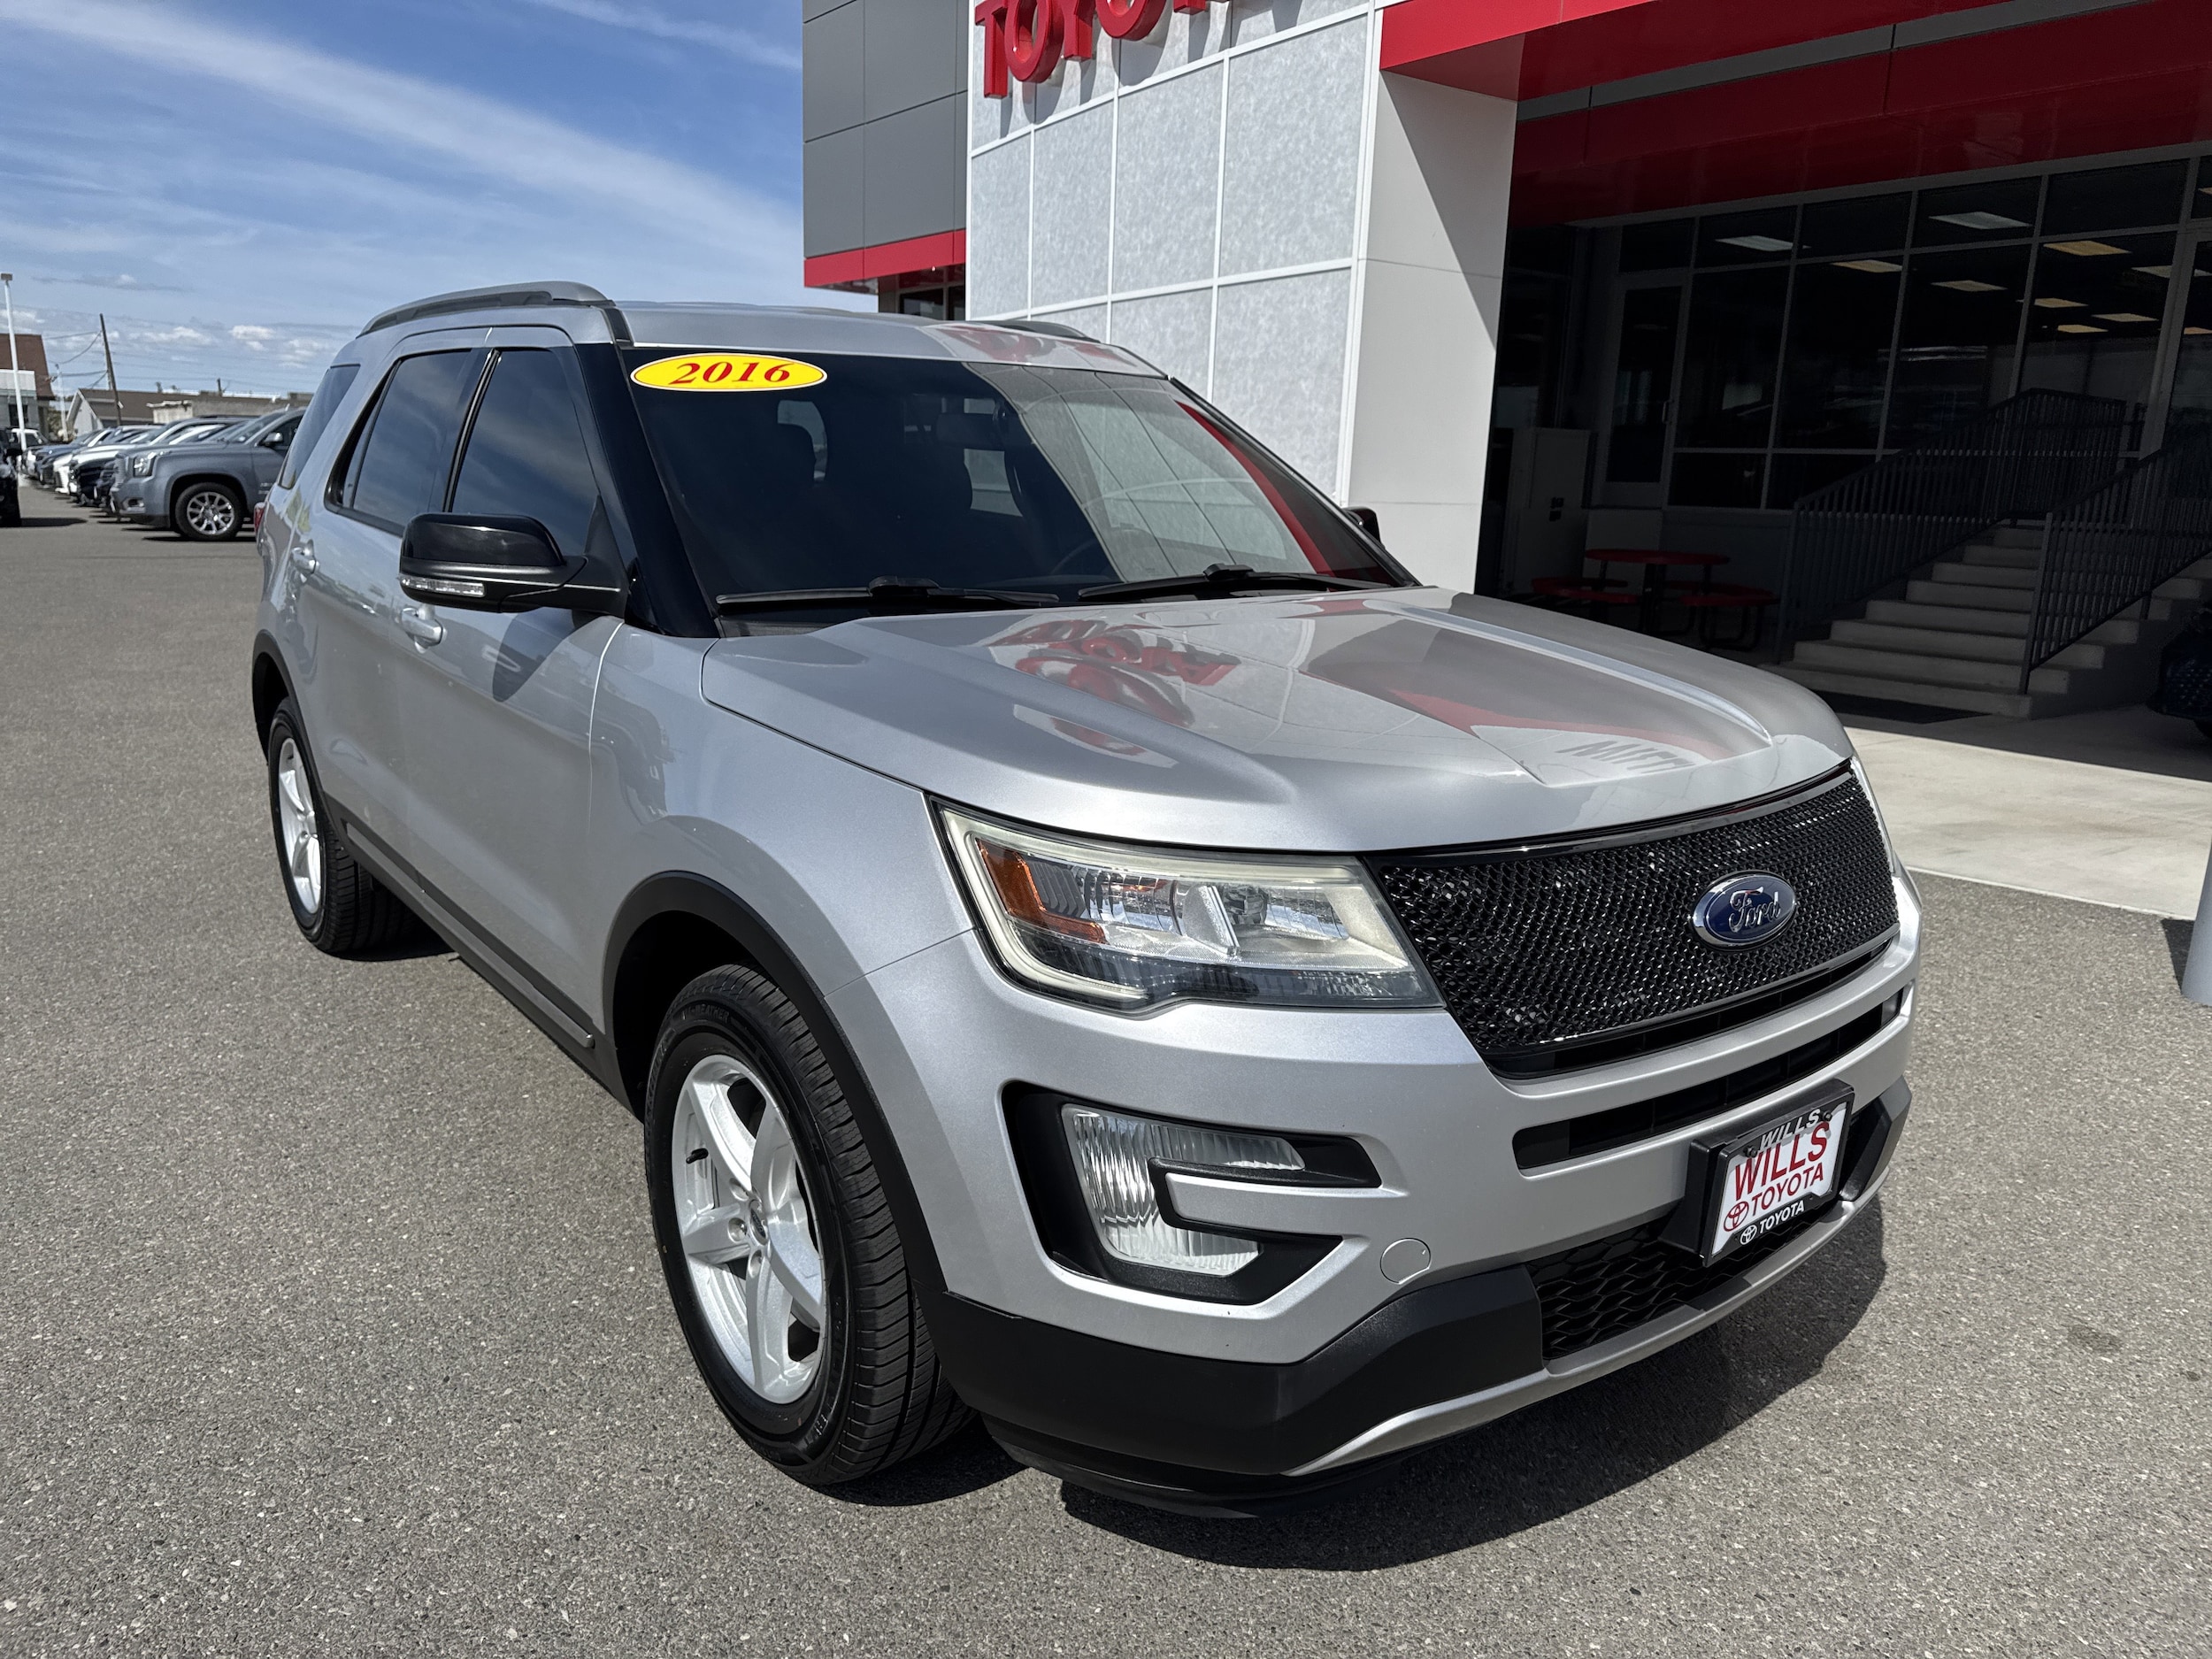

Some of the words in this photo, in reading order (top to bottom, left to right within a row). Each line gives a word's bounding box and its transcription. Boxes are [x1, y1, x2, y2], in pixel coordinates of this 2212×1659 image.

[975, 0, 1206, 99] TOY
[669, 361, 795, 385] 2016
[1728, 886, 1781, 933] Ford
[1760, 1108, 1821, 1148] WILLS
[1734, 1121, 1830, 1202] WILLS
[1752, 1162, 1824, 1217] TOYOTA
[1759, 1200, 1805, 1234] TOYOTA
